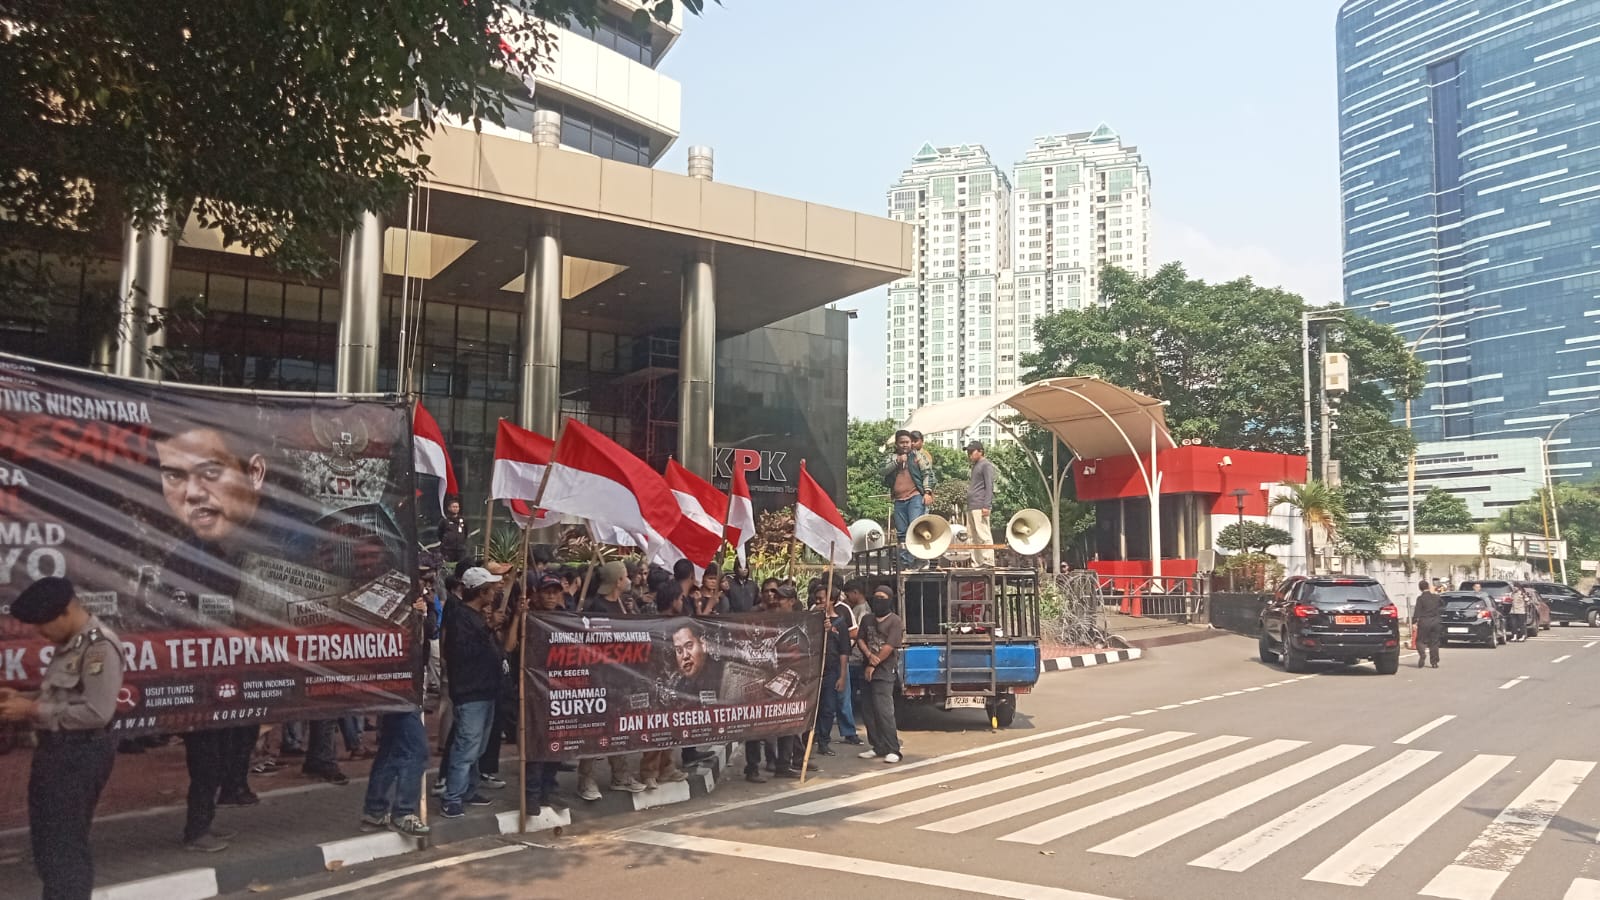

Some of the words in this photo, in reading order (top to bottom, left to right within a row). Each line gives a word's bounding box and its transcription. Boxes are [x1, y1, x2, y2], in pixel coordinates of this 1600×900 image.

[45, 392, 152, 424] NUSANTARA
[712, 447, 787, 481] KPK
[319, 476, 368, 498] KPK
[0, 522, 66, 545] MAD
[0, 547, 67, 584] YO
[267, 570, 288, 582] SUAP
[548, 632, 584, 644] JARINGAN
[585, 631, 613, 643] AKTIVIS
[613, 631, 652, 643] NUSANTARA
[165, 635, 290, 669] TETAPKAN
[295, 633, 403, 662] TERSANGKA!
[546, 642, 653, 668] MENDESAK!
[548, 670, 563, 678] KPK
[563, 668, 590, 677] SEGERA
[145, 687, 166, 697] USUT
[167, 684, 195, 695] TUNTAS
[243, 680, 264, 690] UNTUK
[265, 679, 296, 689] INDONESIA
[243, 690, 260, 700] YANG
[261, 689, 283, 699] BERSIH
[549, 687, 607, 701] MUHAMMAD
[145, 697, 173, 708] ALIRAN
[174, 695, 195, 706] DANA
[550, 697, 607, 717] SURYO
[619, 715, 643, 732] DAN
[647, 714, 670, 730] KPK
[672, 709, 711, 728] SEGERA
[713, 704, 762, 723] TETAPKAN
[764, 700, 807, 718] TERSANGKA!
